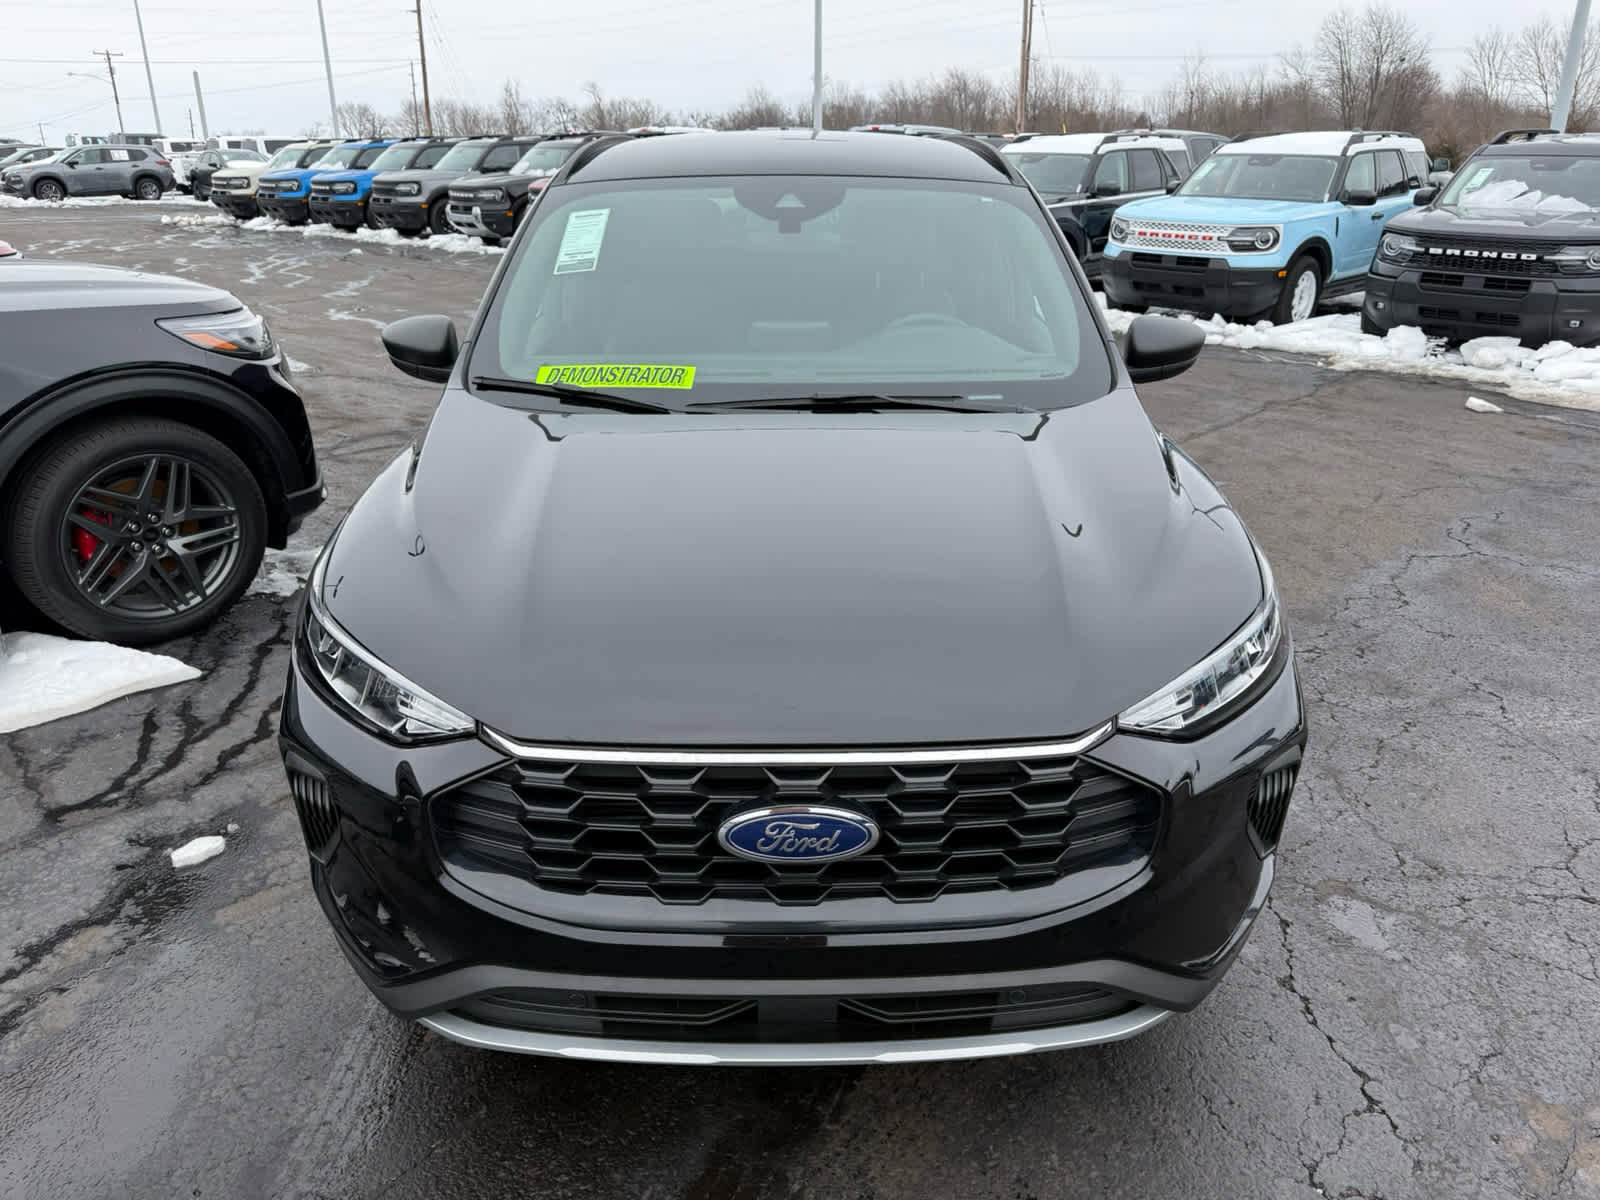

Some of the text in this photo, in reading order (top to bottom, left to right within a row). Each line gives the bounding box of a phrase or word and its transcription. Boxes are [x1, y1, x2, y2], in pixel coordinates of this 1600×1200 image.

[1138, 231, 1213, 241] BRONCO
[1428, 247, 1537, 260] BRONCO
[545, 366, 687, 385] DEMONSTRATOR
[756, 821, 842, 853] Ford
